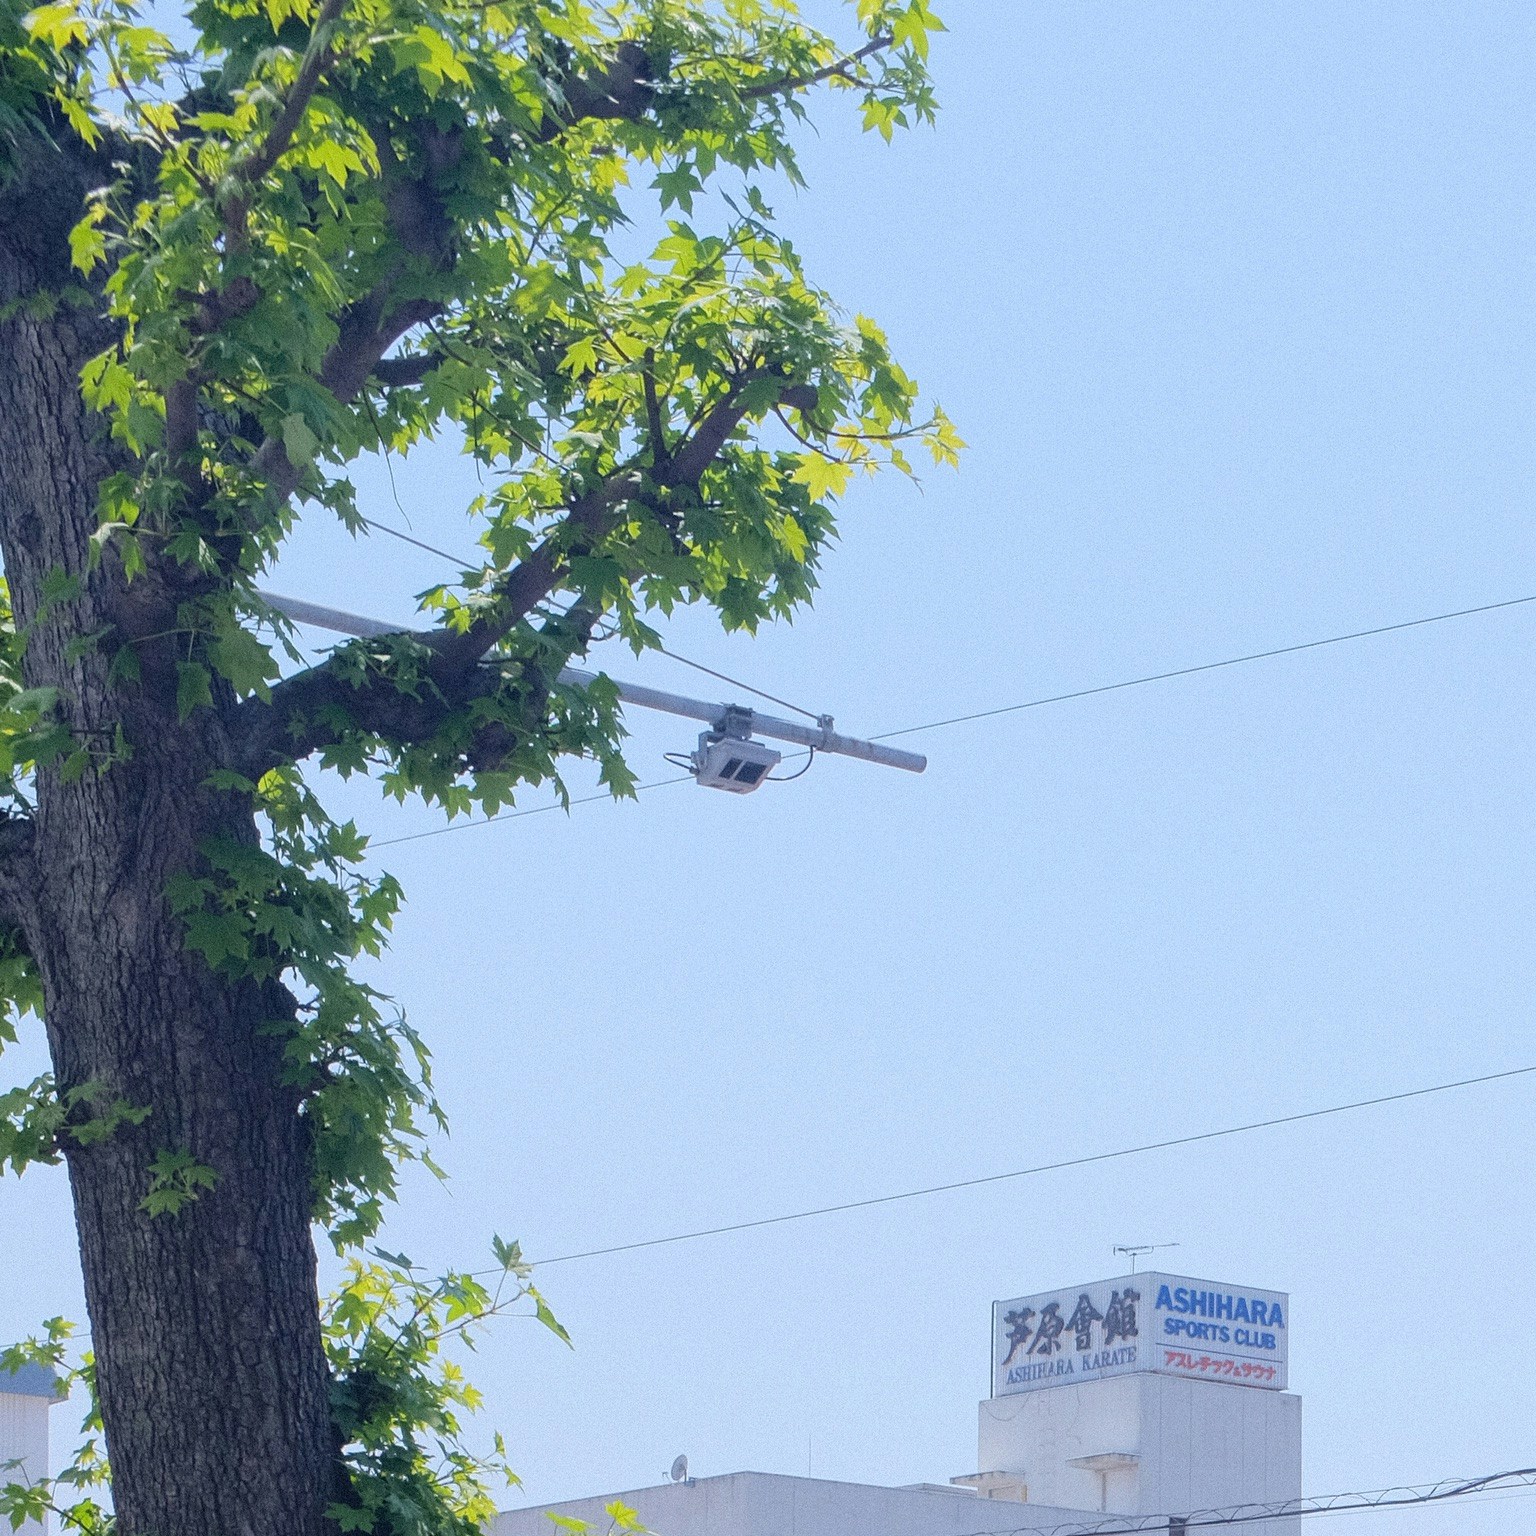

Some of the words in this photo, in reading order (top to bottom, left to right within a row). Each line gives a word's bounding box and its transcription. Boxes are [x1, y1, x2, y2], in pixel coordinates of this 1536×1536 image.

[1155, 1285, 1284, 1329] ASHIHARA
[1164, 1318, 1230, 1343] SPORTS
[1234, 1328, 1276, 1350] CLUB
[1006, 1358, 1074, 1385] ASHIHARA
[1082, 1346, 1137, 1371] KARATE
